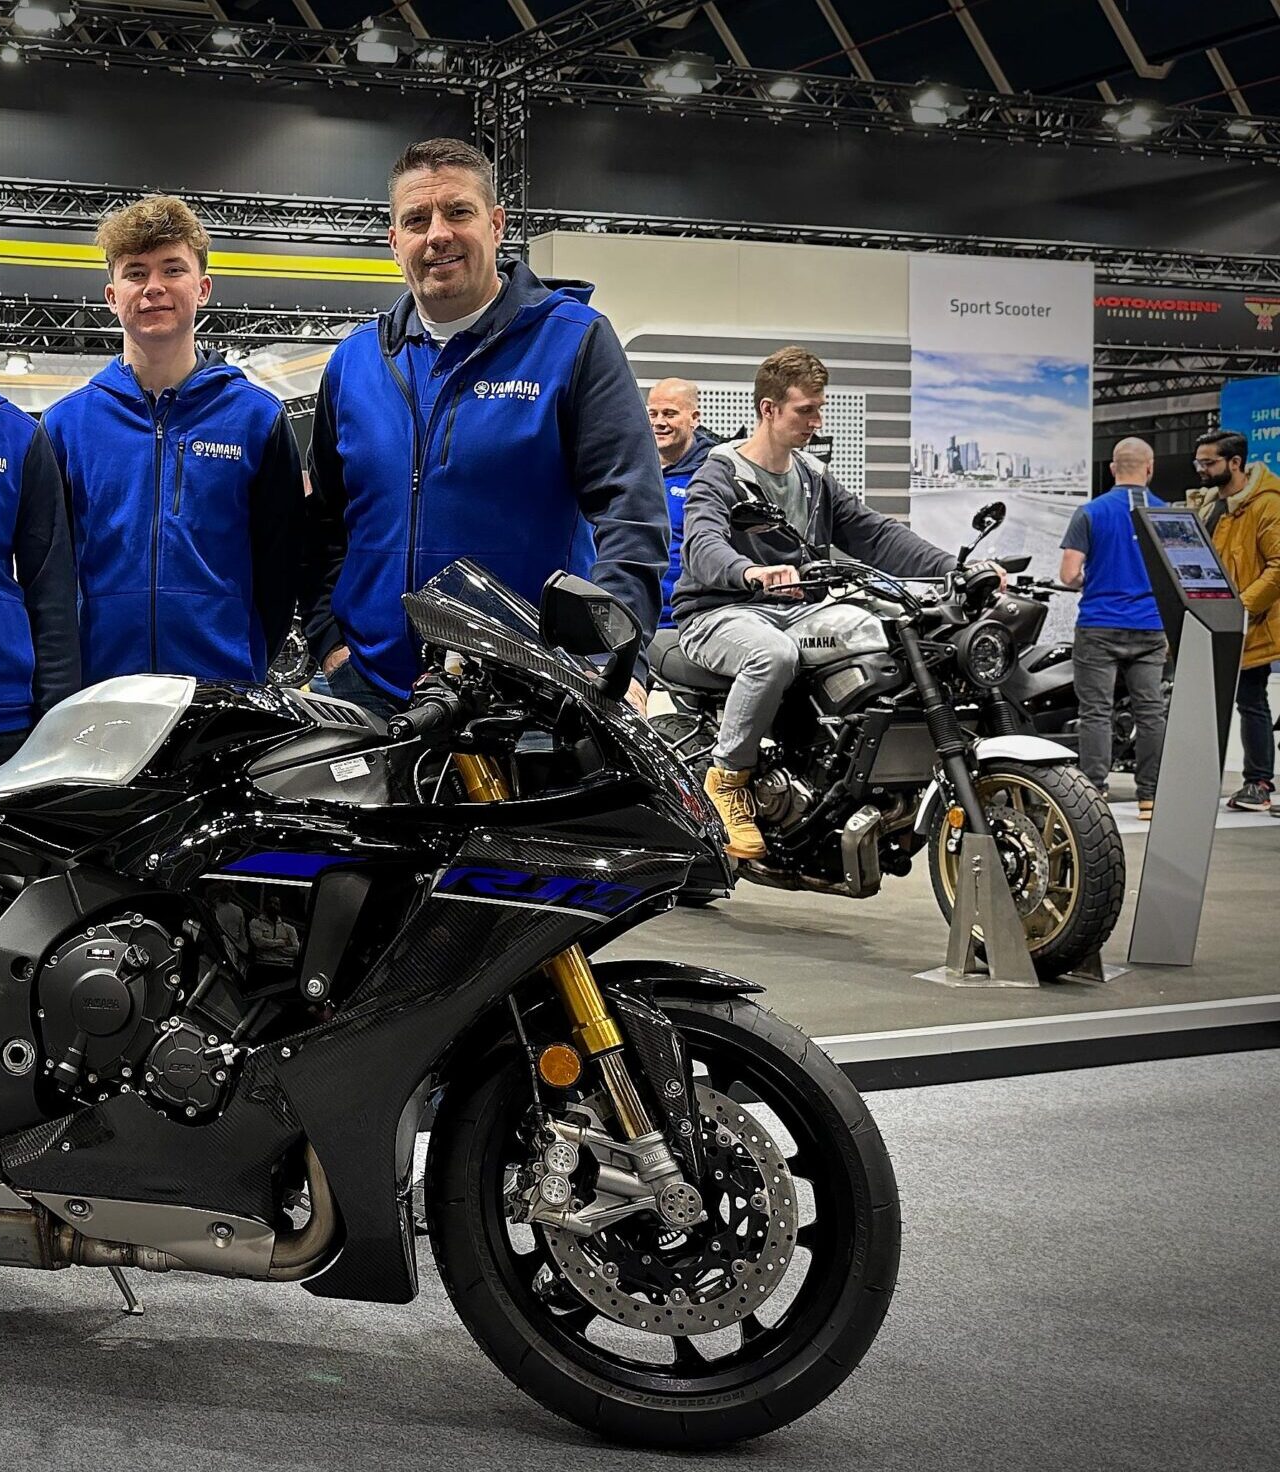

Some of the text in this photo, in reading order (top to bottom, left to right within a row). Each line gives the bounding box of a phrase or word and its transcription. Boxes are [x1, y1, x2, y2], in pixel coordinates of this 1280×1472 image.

[950, 299, 1052, 317] Sport Scooter
[490, 380, 540, 396] YAMAHA
[477, 393, 536, 401] RACING
[195, 452, 240, 461] RACING
[204, 442, 242, 457] YAMAHA
[799, 636, 837, 649] YAMAHA
